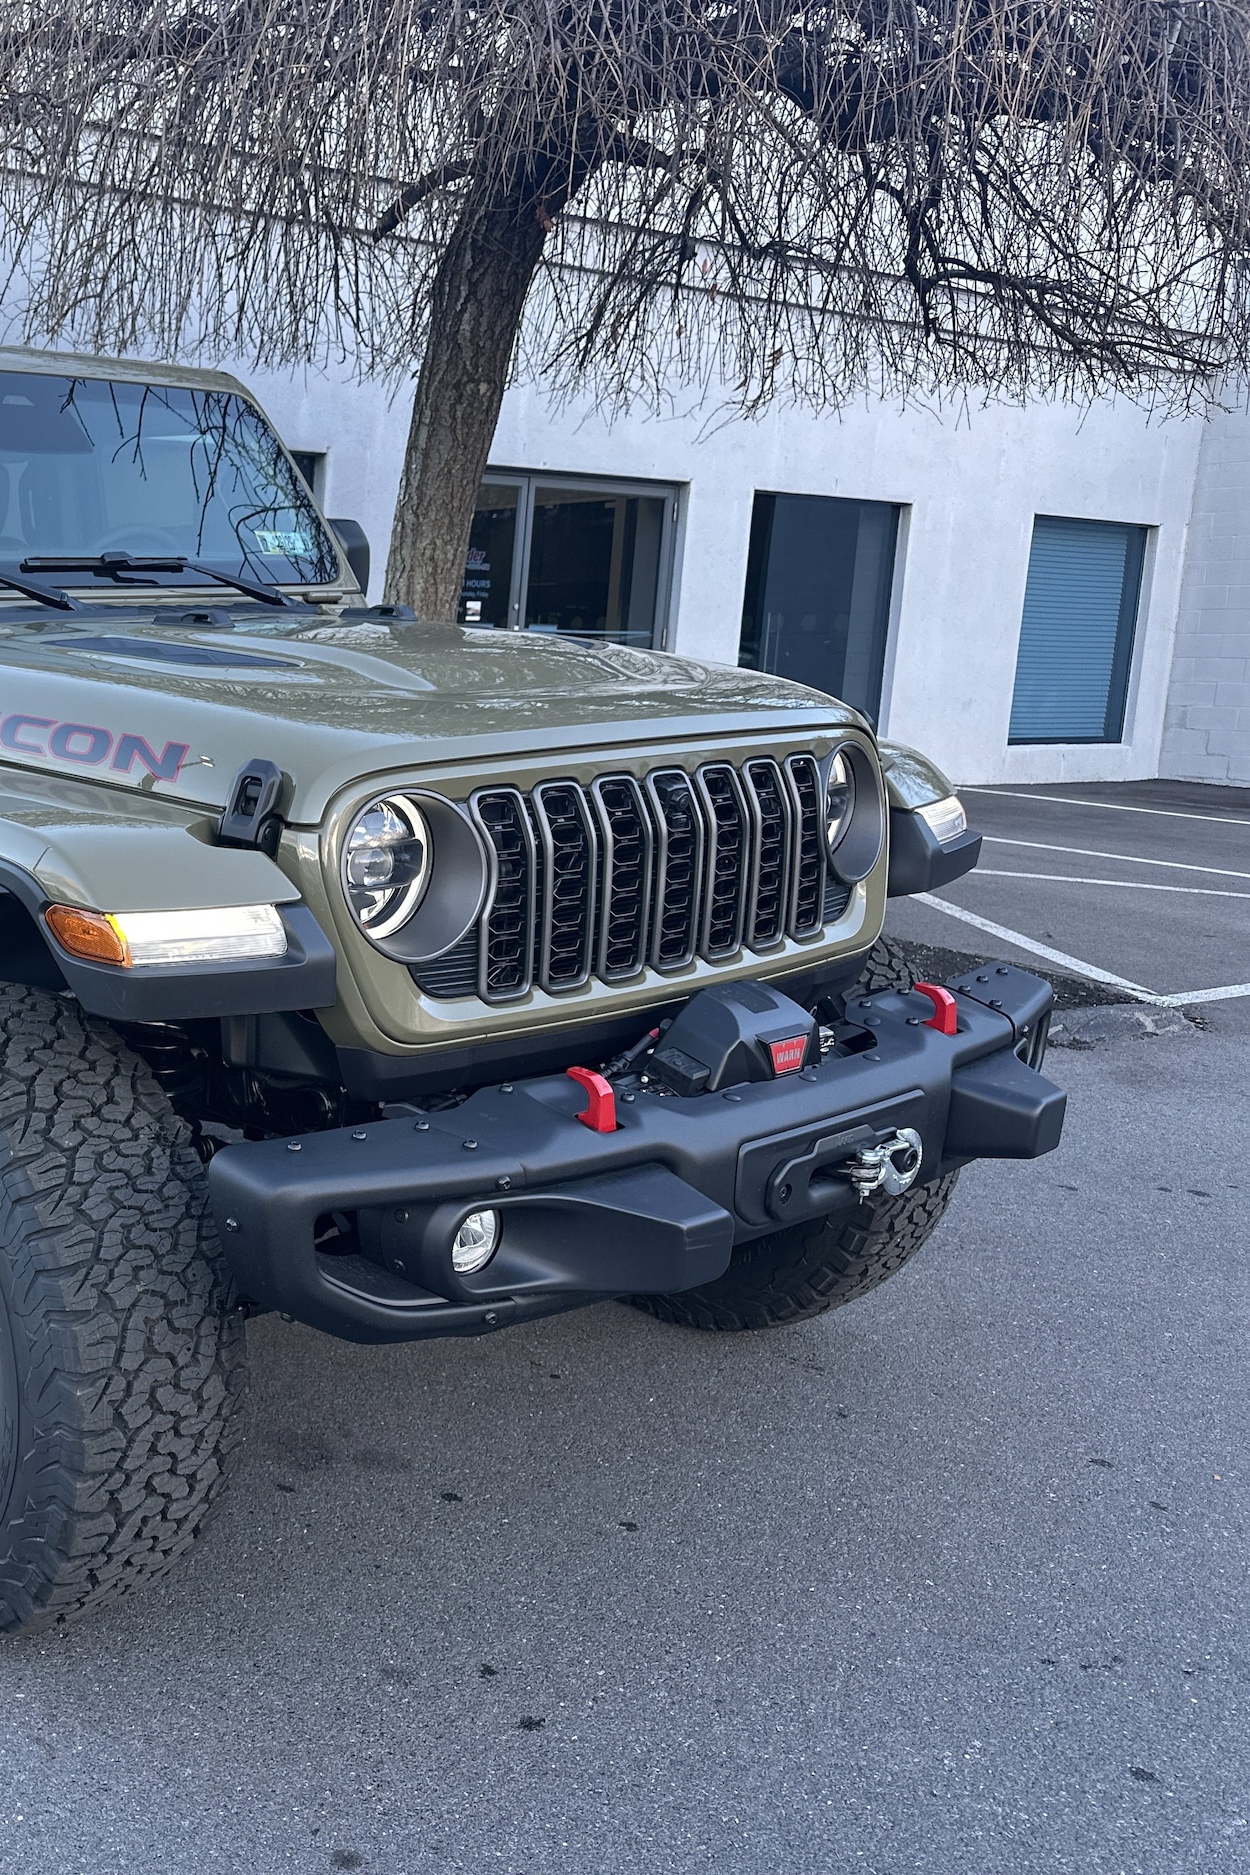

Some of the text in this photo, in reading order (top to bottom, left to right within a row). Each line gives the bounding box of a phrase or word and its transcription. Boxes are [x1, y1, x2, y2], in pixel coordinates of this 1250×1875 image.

[466, 547, 486, 563] der
[466, 580, 491, 589] HOURS
[776, 1047, 801, 1064] WARN
